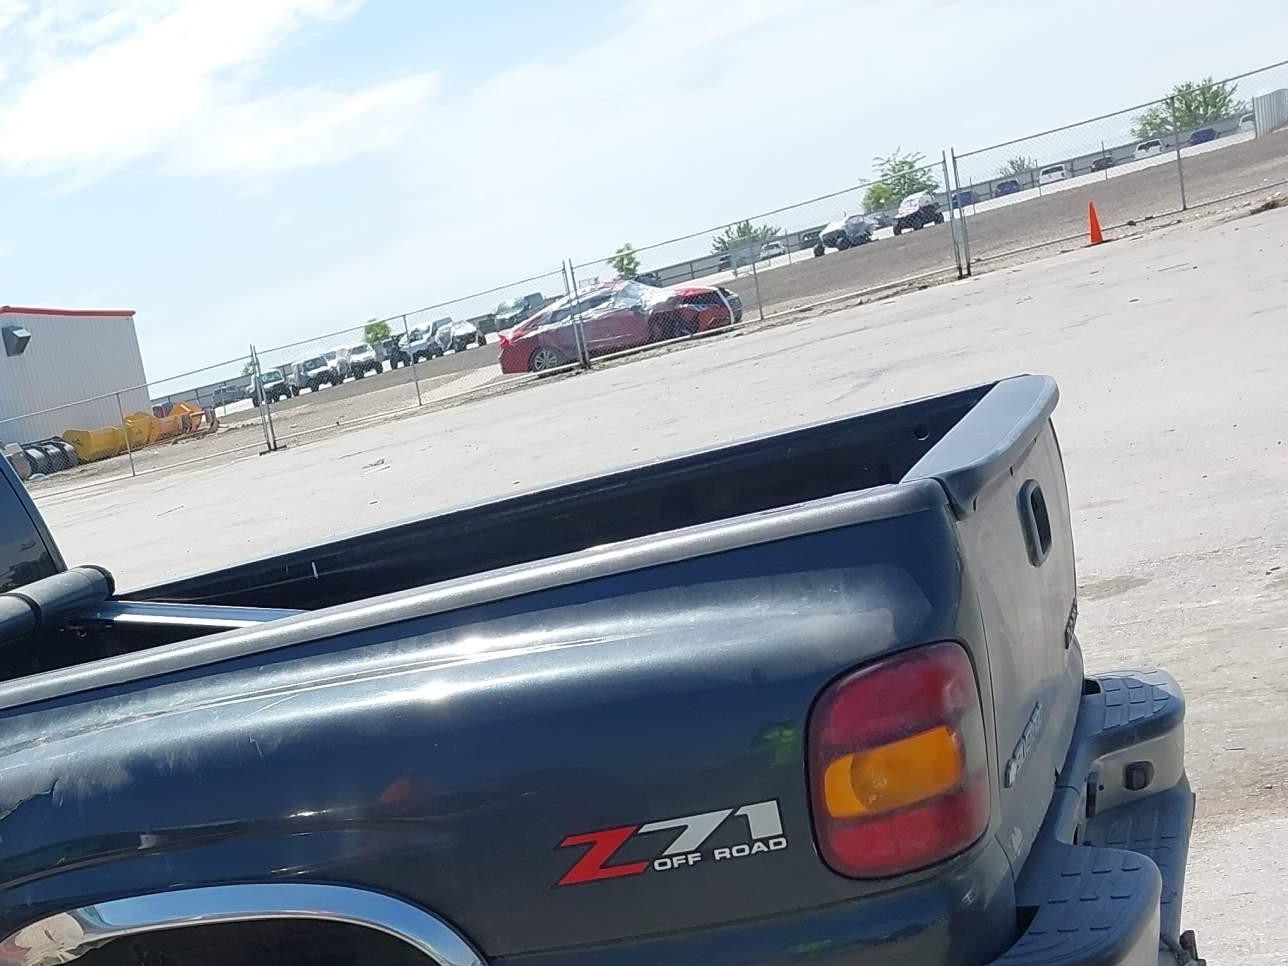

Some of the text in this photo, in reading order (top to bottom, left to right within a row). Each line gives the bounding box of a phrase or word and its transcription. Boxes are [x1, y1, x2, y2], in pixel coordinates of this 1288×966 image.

[557, 799, 784, 887] Z71
[653, 837, 788, 871] OFF ROAD
